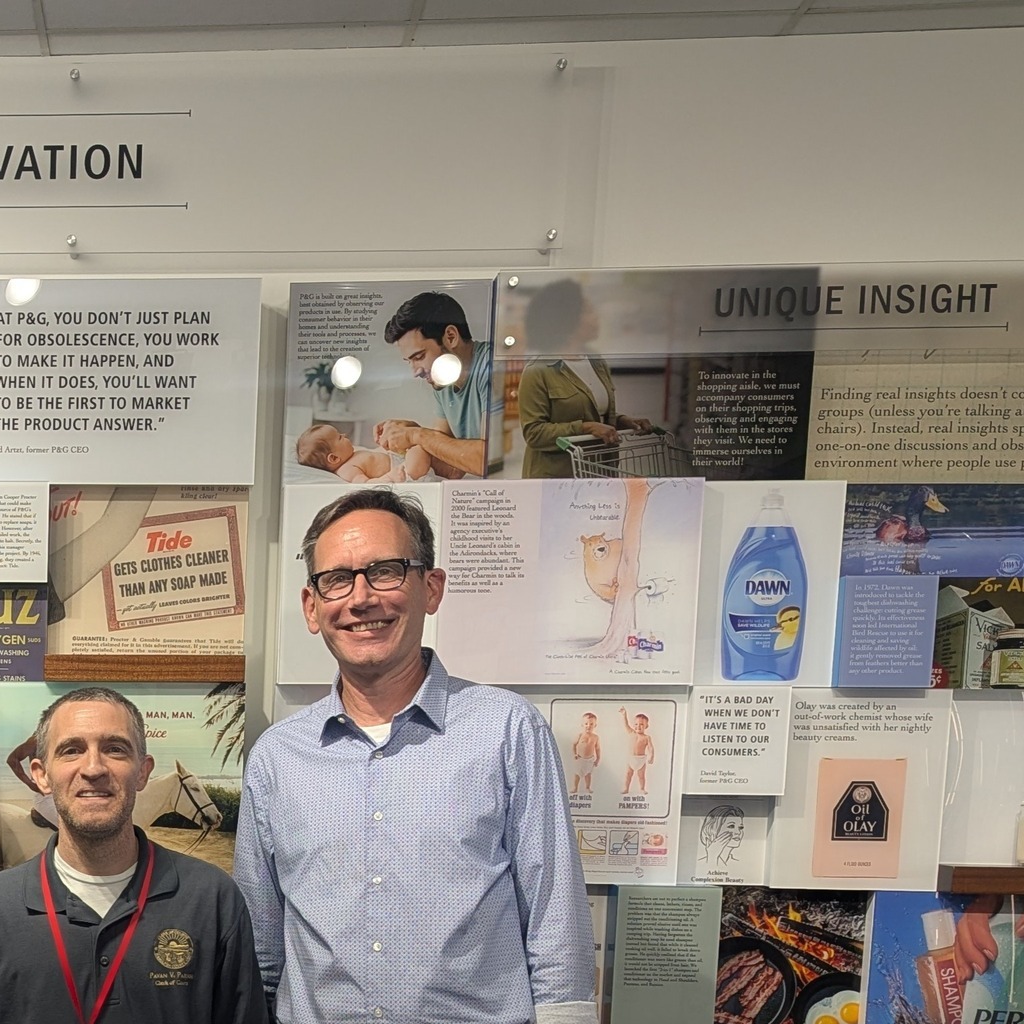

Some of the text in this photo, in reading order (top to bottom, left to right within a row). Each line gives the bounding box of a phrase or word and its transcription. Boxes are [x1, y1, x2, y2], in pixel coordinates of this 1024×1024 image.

[716, 284, 998, 321] UNIQUE INSIGHT
[18, 312, 49, 326] P&G,
[54, 312, 82, 324] YOU
[88, 311, 132, 324] DON'T
[136, 312, 169, 324] JUST
[174, 312, 210, 324] PLAN
[28, 333, 138, 348] OBSOLESCENCE,
[144, 333, 172, 346] YOU
[177, 333, 219, 346] WORK
[18, 355, 57, 367] MAKE
[63, 355, 75, 367] IT
[80, 355, 138, 369] HAPPEN,
[143, 354, 174, 367] AND
[698, 370, 776, 379] To innovate in the
[42, 376, 53, 388] IT
[59, 376, 98, 390] DOES,
[102, 375, 150, 388] YOU'LL
[155, 376, 196, 388] WANT
[821, 387, 1008, 403] Finding real insights doesn't
[17, 397, 32, 409] BE
[37, 397, 62, 409] THE
[68, 397, 105, 410] FIRST
[109, 397, 126, 409] TO
[132, 397, 190, 409] MARKET
[25, 418, 89, 430] PRODUCT
[93, 418, 164, 430] ANSWER."
[146, 530, 193, 553] Tide
[114, 549, 230, 576] GETS CLOTHES CLEANER
[119, 571, 228, 597] THAN ANY SOAP MADE
[745, 580, 791, 596] DAWN
[700, 695, 774, 704] "IT'S A BAD DAY
[704, 709, 780, 717] WHEN WE DON'T
[795, 702, 817, 712] Olay
[838, 702, 870, 710] created
[872, 702, 884, 713] by
[704, 722, 766, 730] HAVE TIME TO
[703, 735, 769, 743] LISTEN TO OUR
[702, 748, 765, 756] CONSUMERS."
[851, 804, 870, 815] Oil
[843, 820, 877, 832] OLAY
